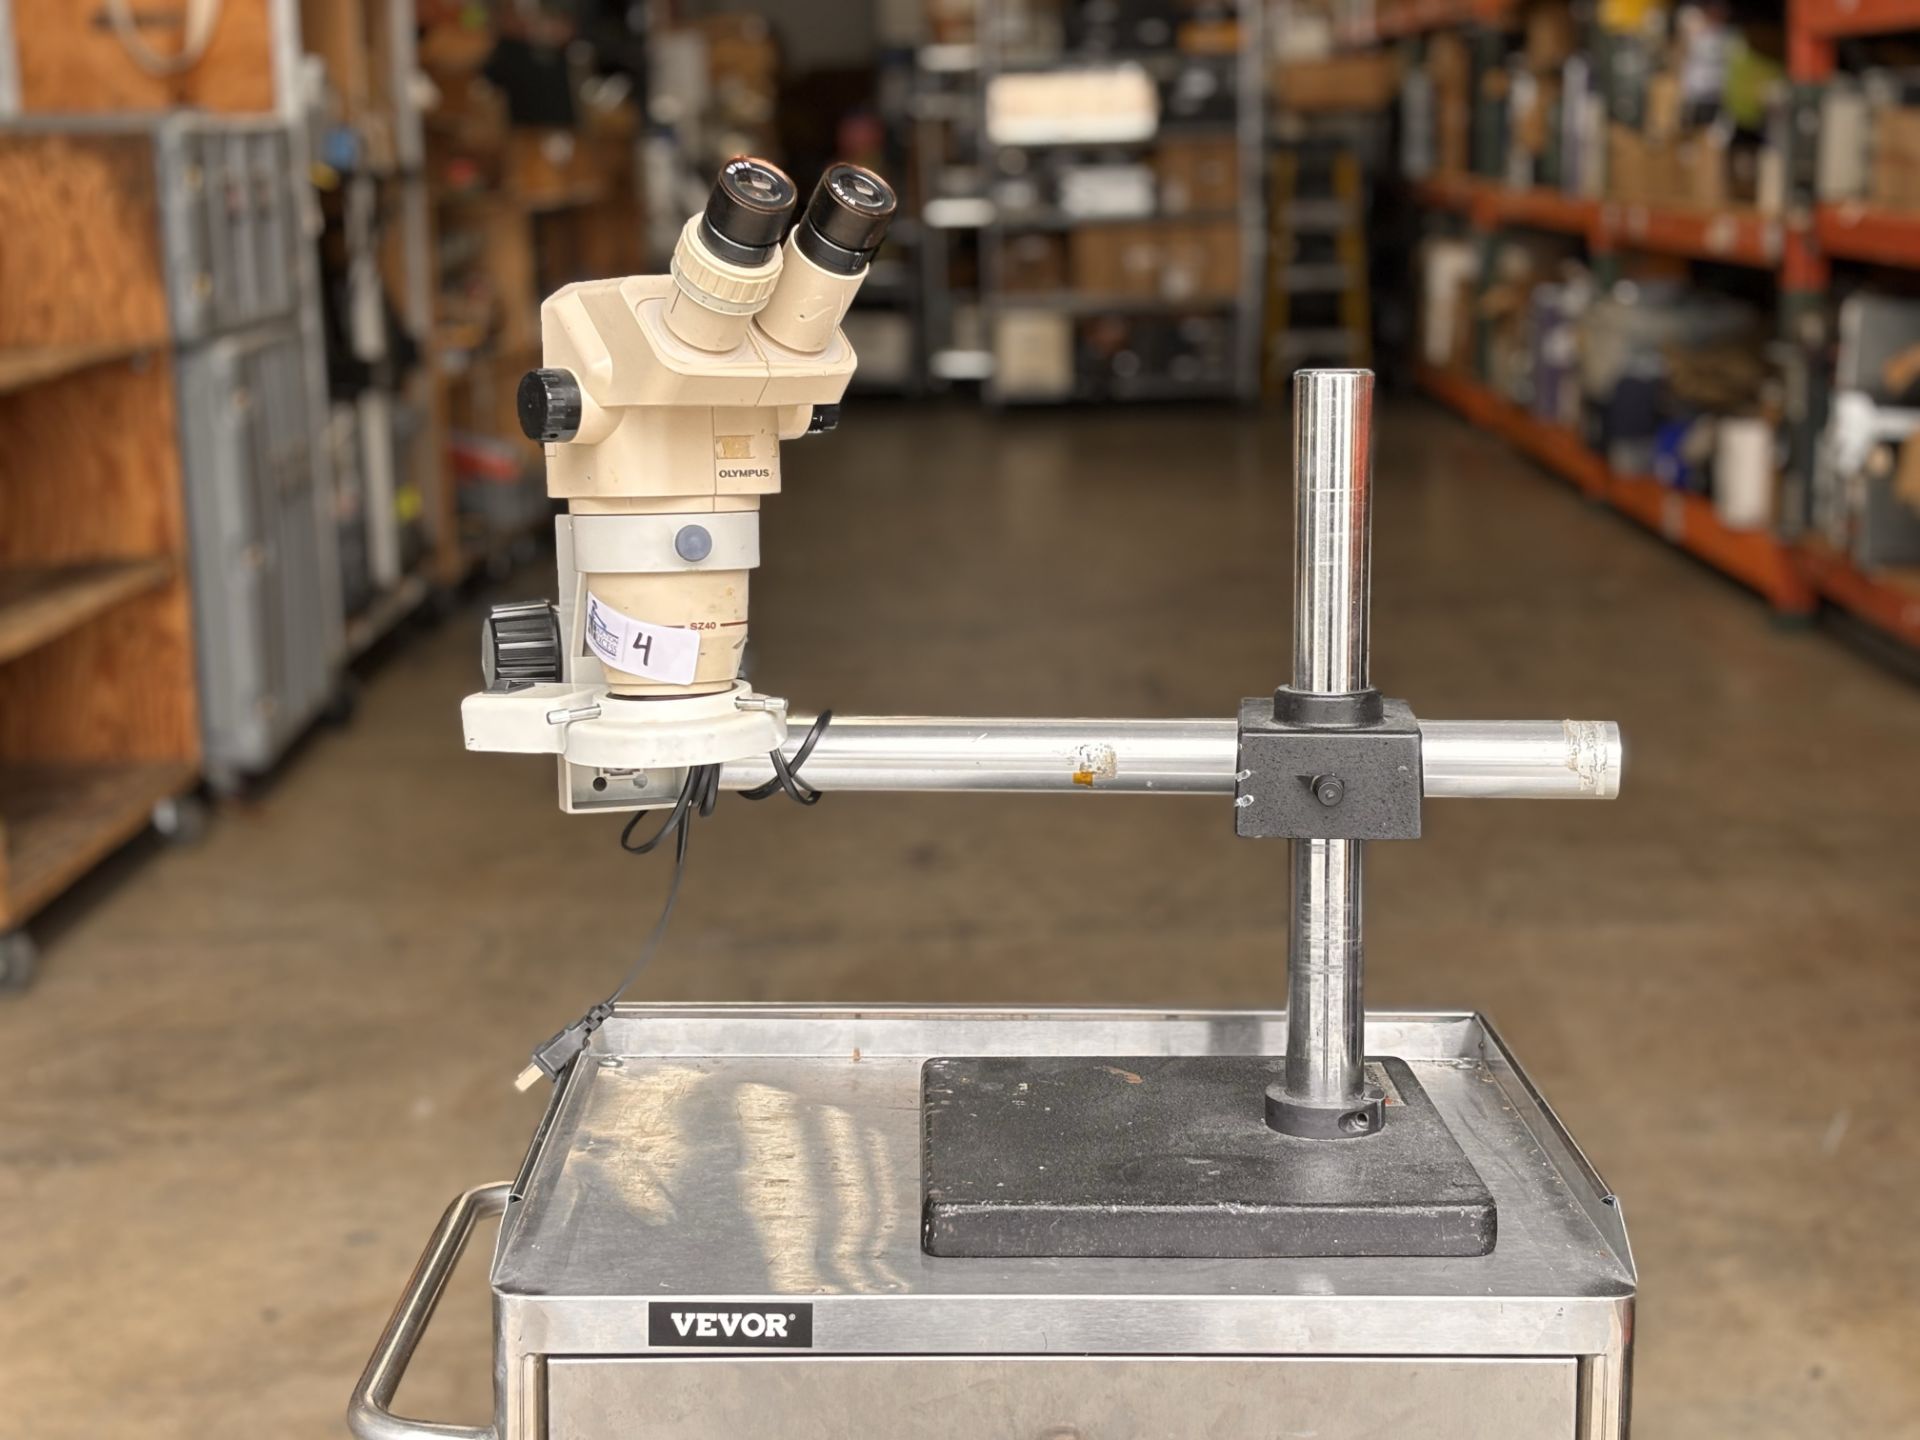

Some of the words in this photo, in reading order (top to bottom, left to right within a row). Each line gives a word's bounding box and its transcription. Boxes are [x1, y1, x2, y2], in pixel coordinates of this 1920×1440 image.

[719, 469, 770, 478] OLYMPUS
[690, 621, 716, 630] SZ40
[632, 631, 653, 667] 4
[670, 1312, 788, 1338] VEVOR
